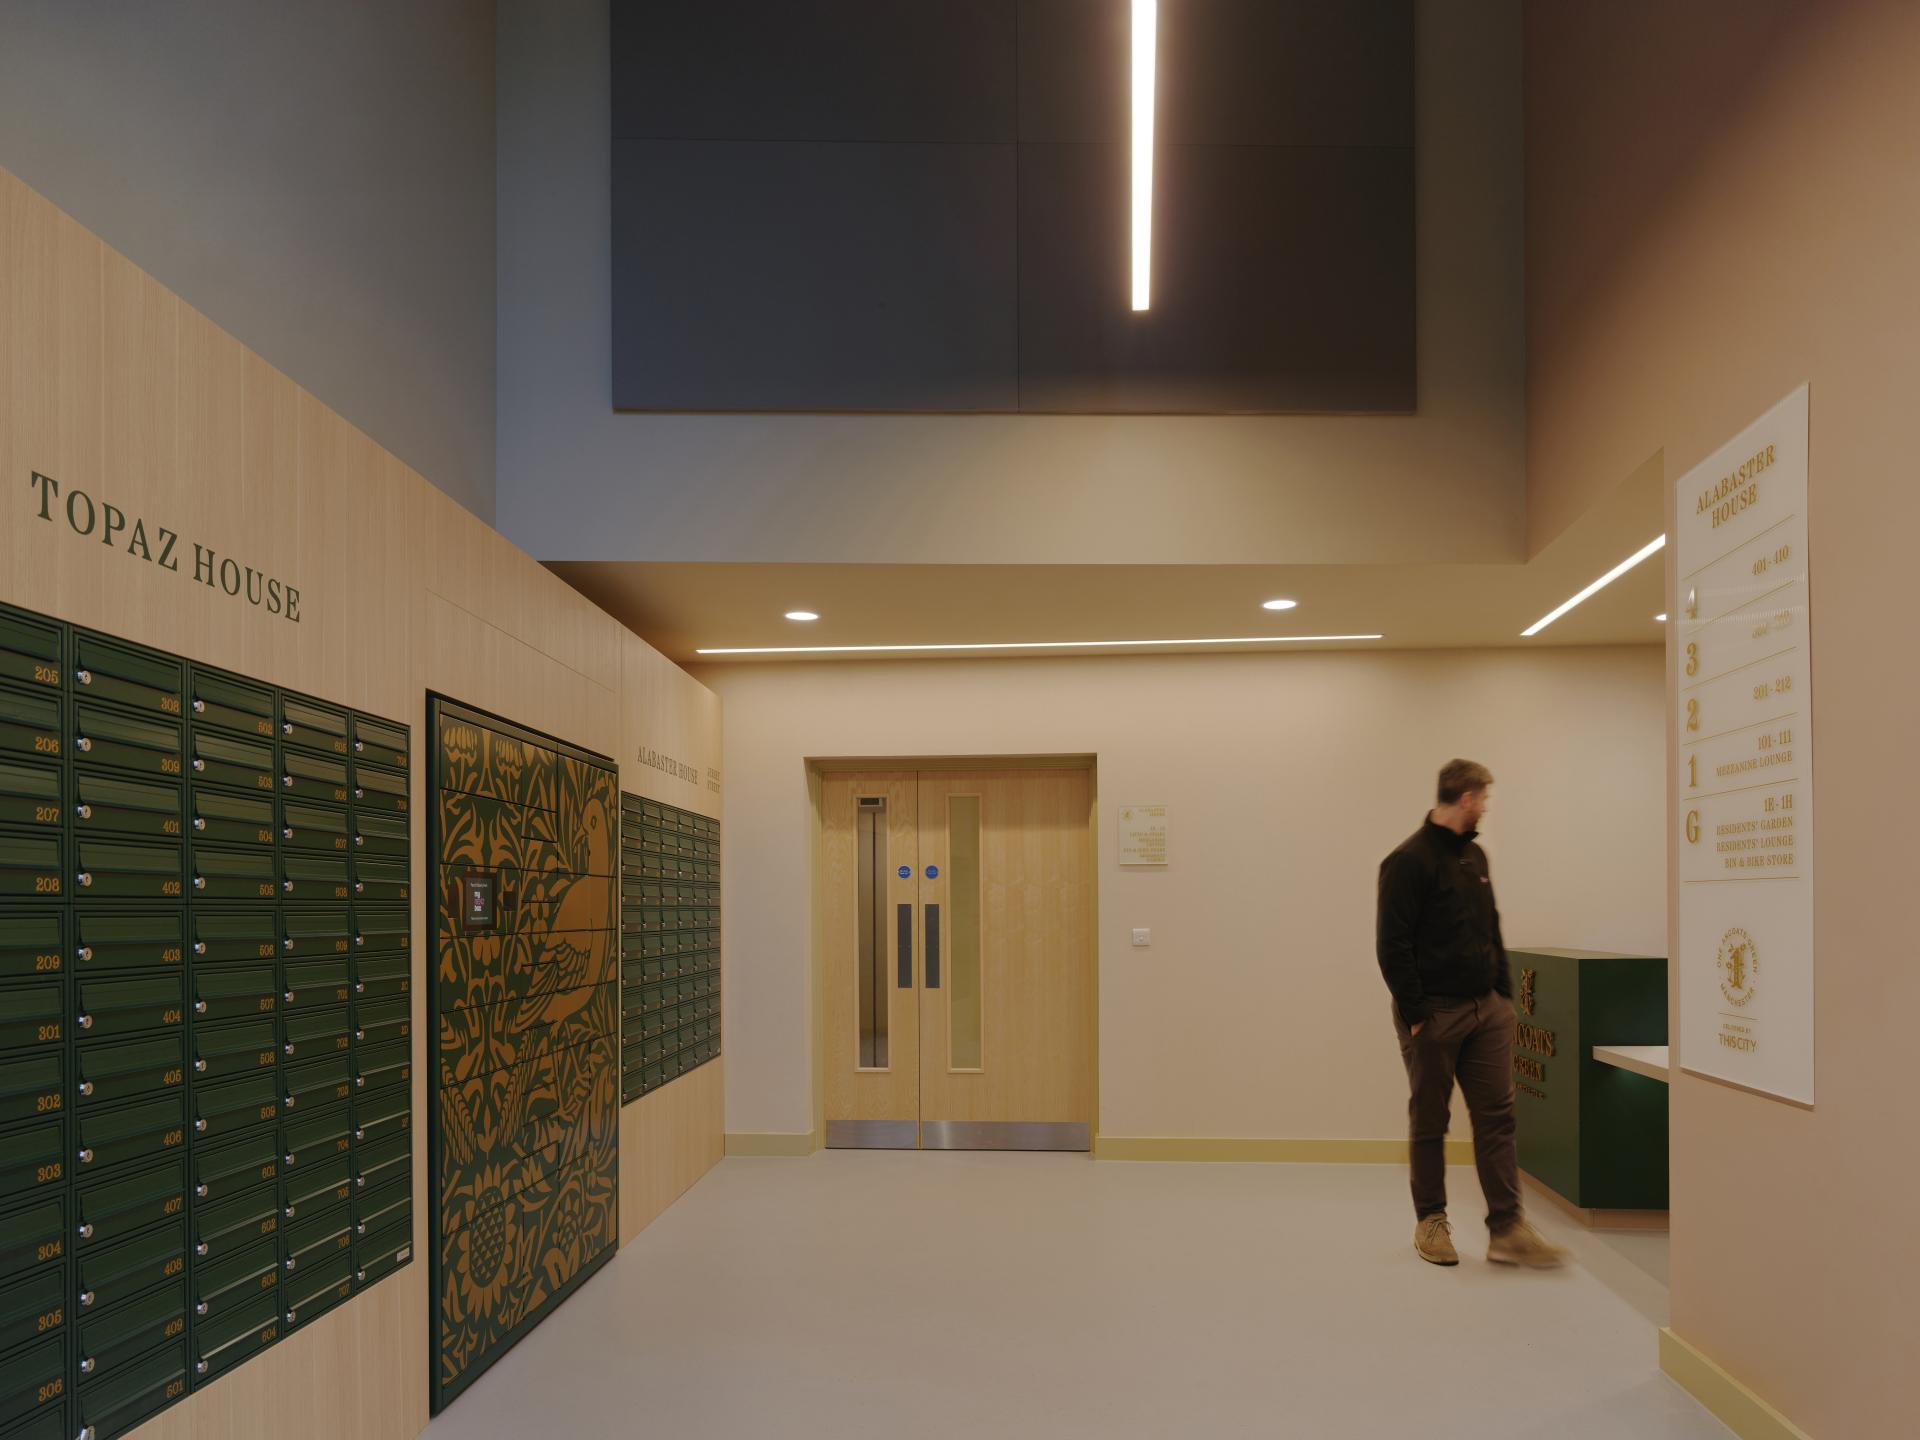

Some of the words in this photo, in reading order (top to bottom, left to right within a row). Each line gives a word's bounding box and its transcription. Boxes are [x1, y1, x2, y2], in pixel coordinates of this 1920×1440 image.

[1696, 444, 1777, 516] ALABASTER
[1711, 482, 1759, 530] HOUSE
[30, 469, 179, 572] TOPAZ
[191, 542, 301, 623] HOUSE
[1685, 641, 1698, 678] 3
[34, 666, 59, 684] 205
[159, 696, 180, 712] 308
[1685, 697, 1699, 734] 2
[34, 737, 60, 753] 206
[161, 758, 181, 773] 309
[637, 745, 678, 777] ALABASTER
[678, 762, 698, 785] HOUSE
[1759, 750, 1793, 768] LOUNGE
[1687, 754, 1697, 790] 1
[35, 807, 60, 822] 207
[162, 820, 180, 833] 401
[1685, 809, 1701, 844] G
[1760, 815, 1793, 831] GARDEN
[1760, 834, 1794, 849] LOUNGE
[1766, 852, 1794, 866] STORE
[35, 877, 60, 892] 208
[161, 881, 181, 894] 402
[35, 955, 61, 970] 209
[162, 949, 181, 961] 403
[162, 1010, 182, 1023] 404
[38, 1025, 61, 1040] 301
[162, 1069, 182, 1084] 405
[37, 1094, 61, 1111] 302
[163, 1130, 182, 1145] 406
[37, 1163, 62, 1182] 303
[163, 1197, 182, 1213] 407
[37, 1240, 62, 1260] 304
[163, 1258, 183, 1275] 408
[37, 1311, 63, 1331] 305
[164, 1319, 183, 1336] 409
[38, 1379, 63, 1401] 306
[166, 1380, 183, 1396] 501
